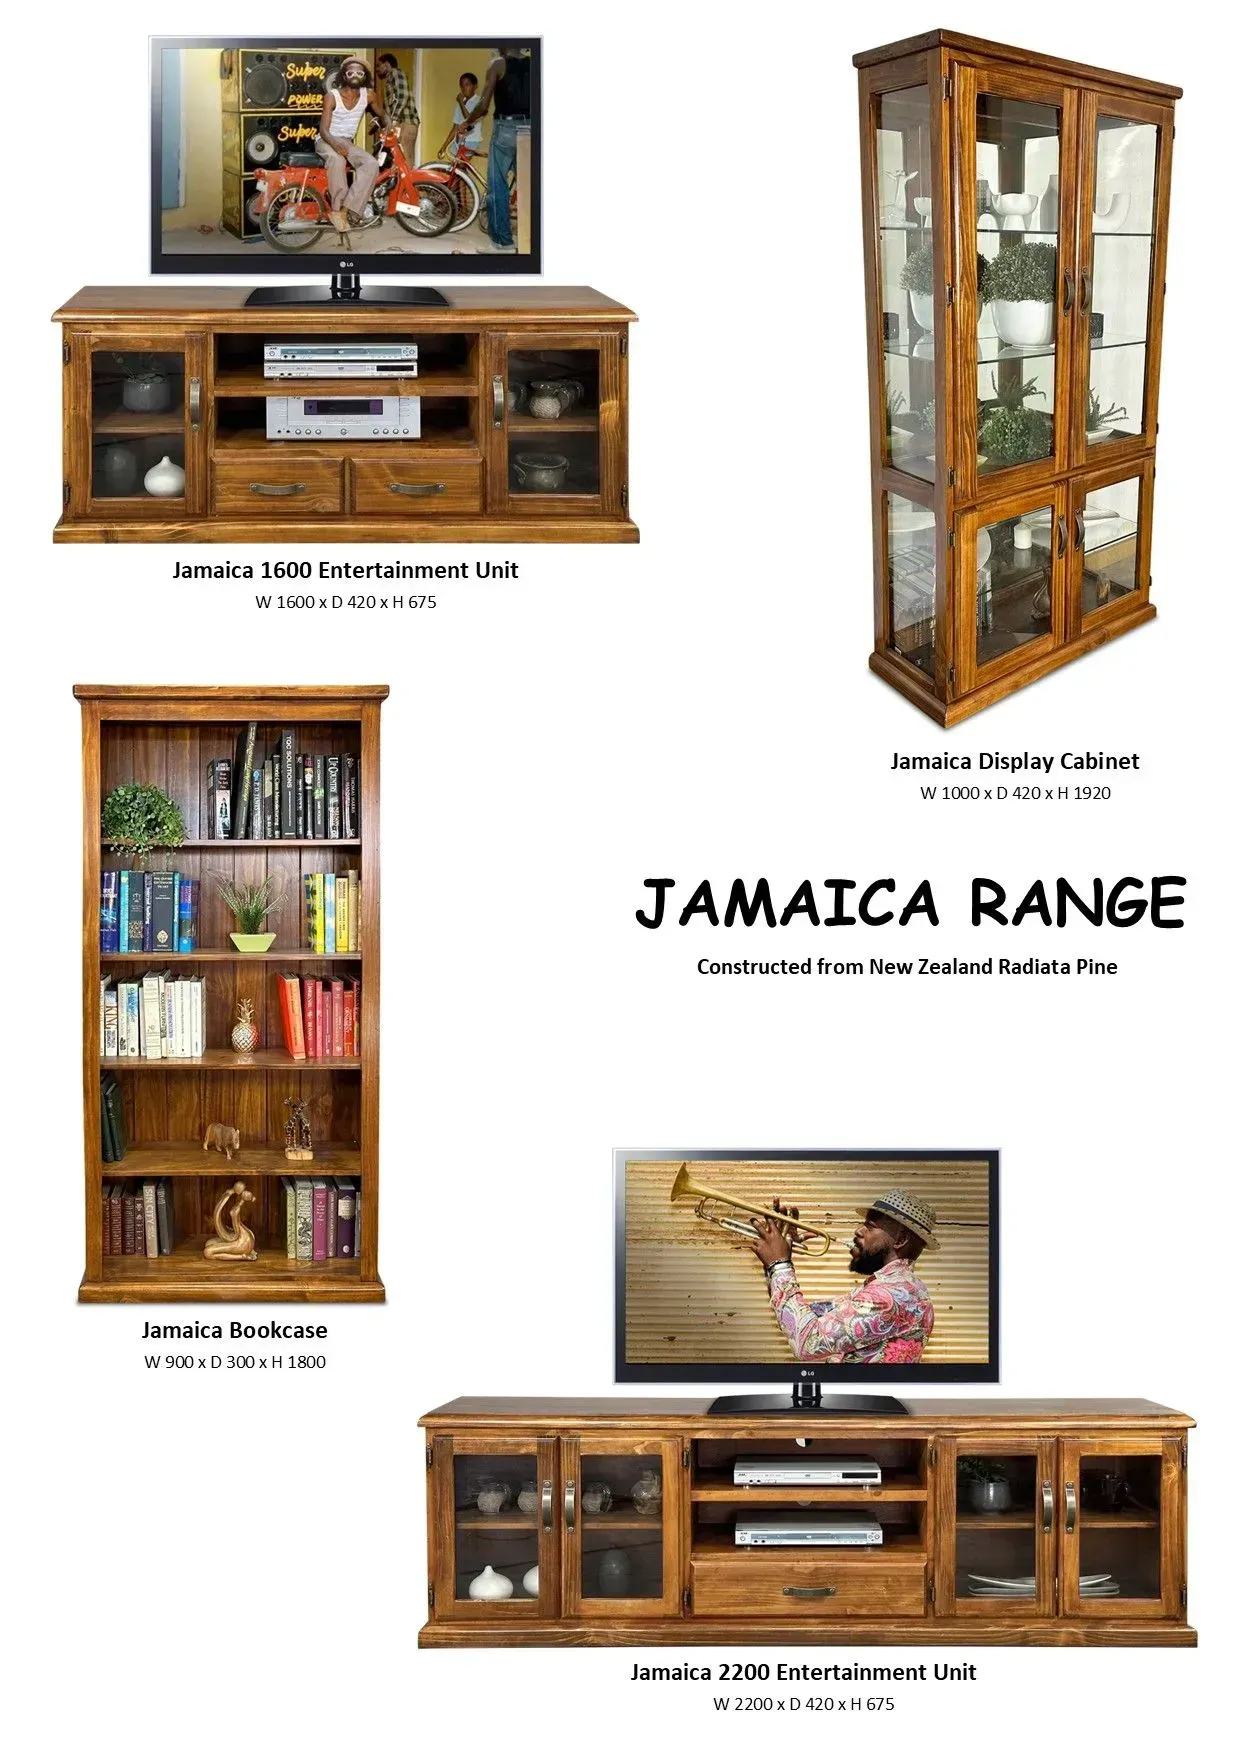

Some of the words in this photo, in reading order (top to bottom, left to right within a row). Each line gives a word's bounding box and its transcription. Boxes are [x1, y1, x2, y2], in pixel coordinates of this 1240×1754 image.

[286, 62, 326, 81] Super
[288, 93, 323, 105] POWER
[278, 123, 318, 143] Super
[105, 1006, 117, 1029] KING
[145, 1189, 153, 1203] SIN
